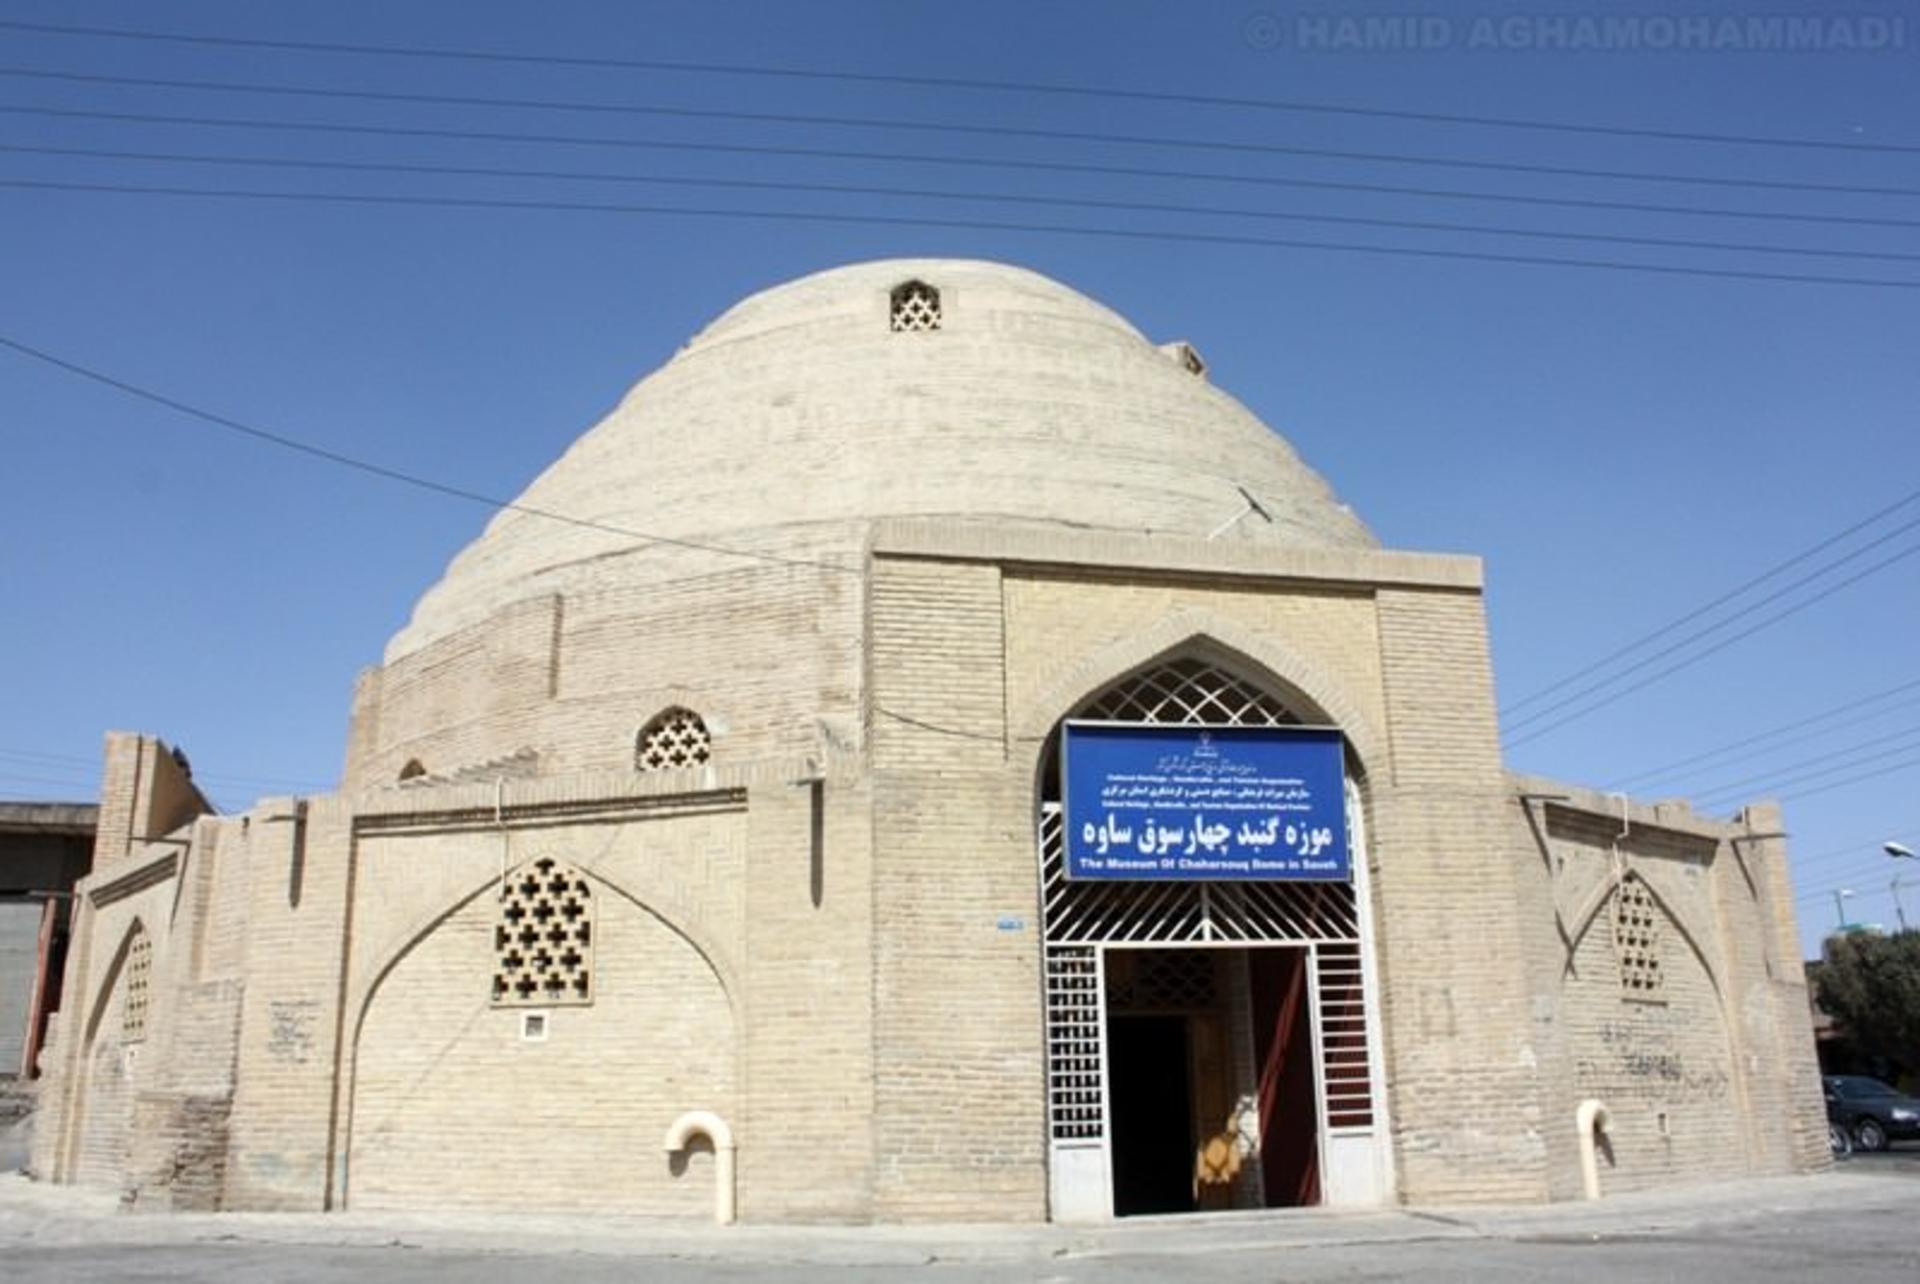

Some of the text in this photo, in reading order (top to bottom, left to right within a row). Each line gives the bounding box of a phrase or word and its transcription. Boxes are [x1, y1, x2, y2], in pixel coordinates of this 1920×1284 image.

[1083, 813, 1132, 854] ساوه
[1237, 816, 1280, 854] گنبد
[1285, 821, 1333, 855] موزه
[1080, 858, 1103, 869] The
[1106, 858, 1157, 869] Museum
[1160, 858, 1175, 869] Of
